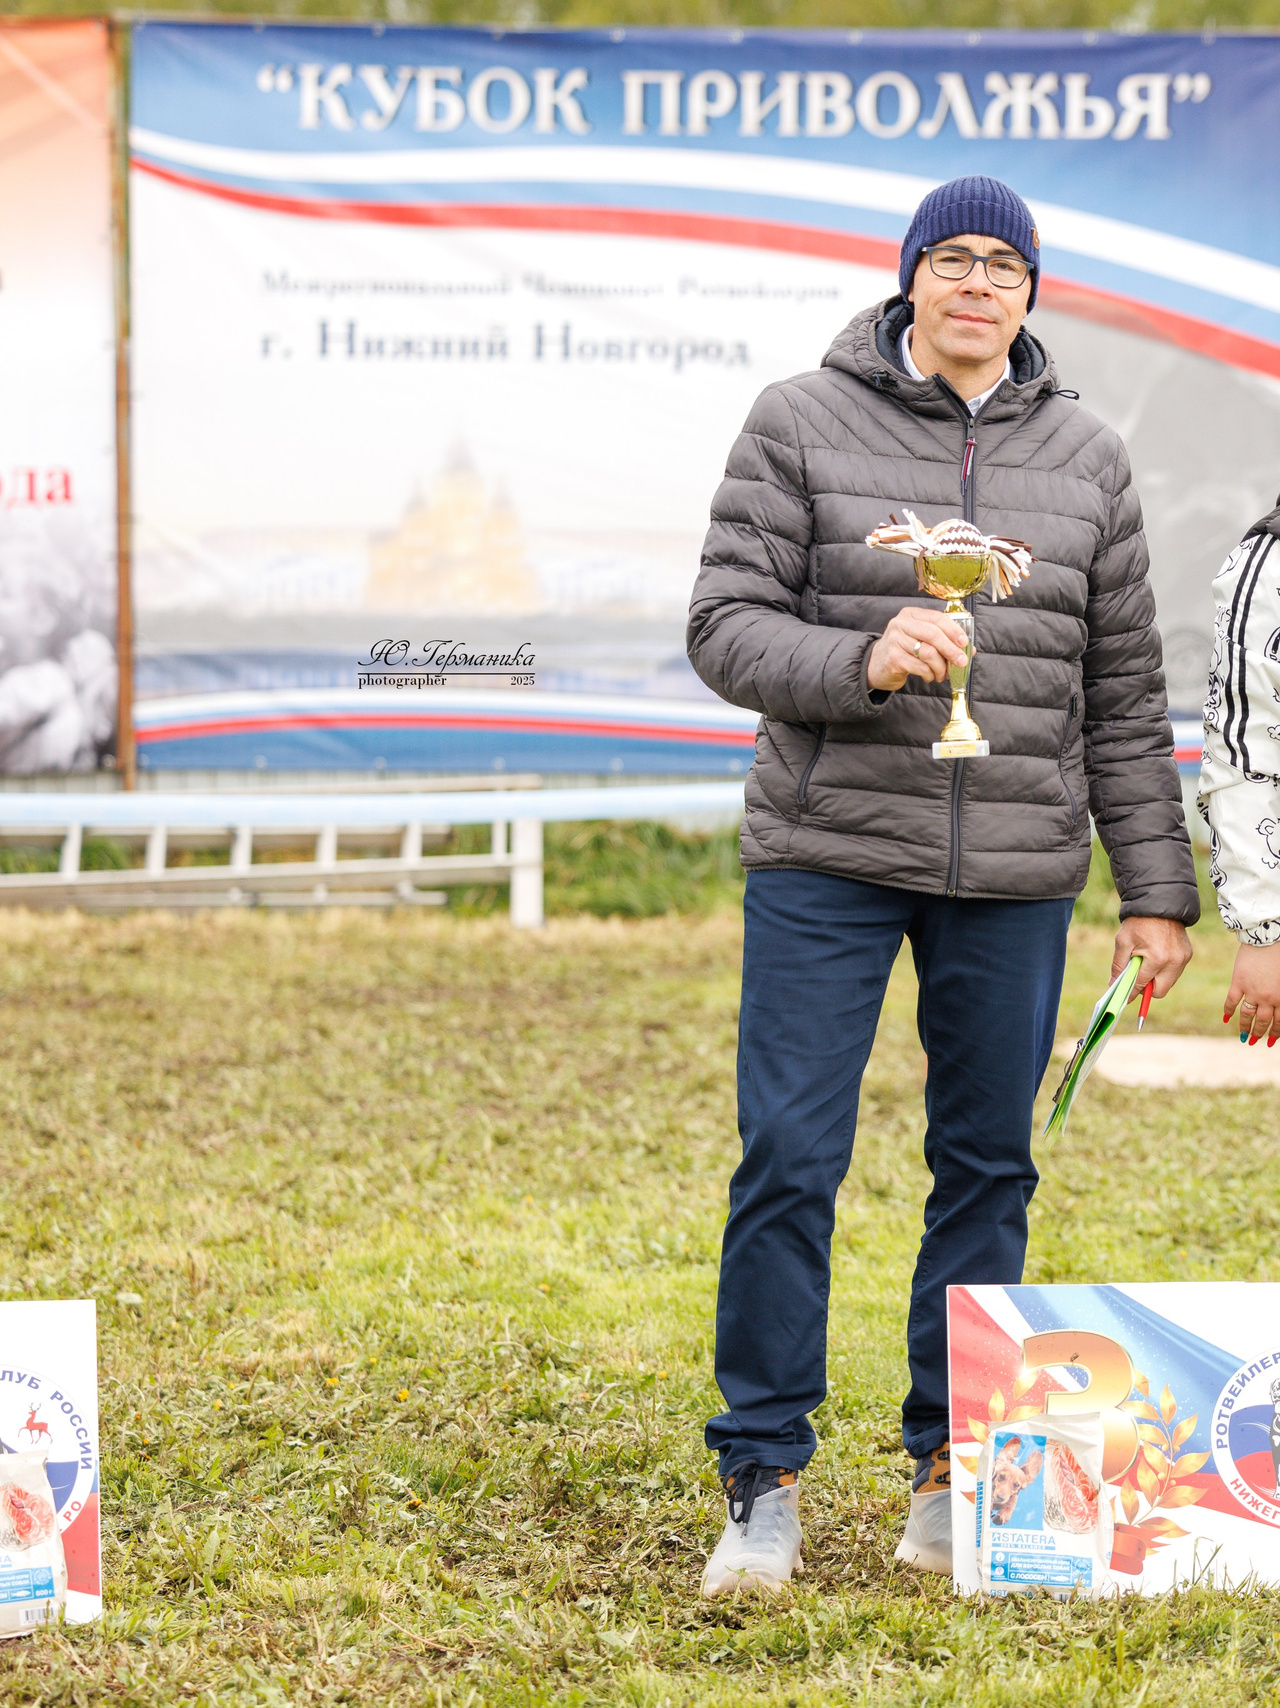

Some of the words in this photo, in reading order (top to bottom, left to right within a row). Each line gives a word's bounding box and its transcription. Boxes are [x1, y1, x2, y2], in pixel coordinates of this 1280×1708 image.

[256, 63, 591, 135] “КУБОК
[620, 69, 1213, 141] ПРИВОЛЖЬЯ”
[317, 317, 509, 362] Нижний
[533, 322, 750, 373] Новгород
[0, 1369, 42, 1390] ЛУБ
[49, 1390, 93, 1470] РОССИИ
[1022, 1329, 1139, 1483] 3
[62, 1500, 82, 1523] РО
[1002, 1532, 1056, 1545] STATERA
